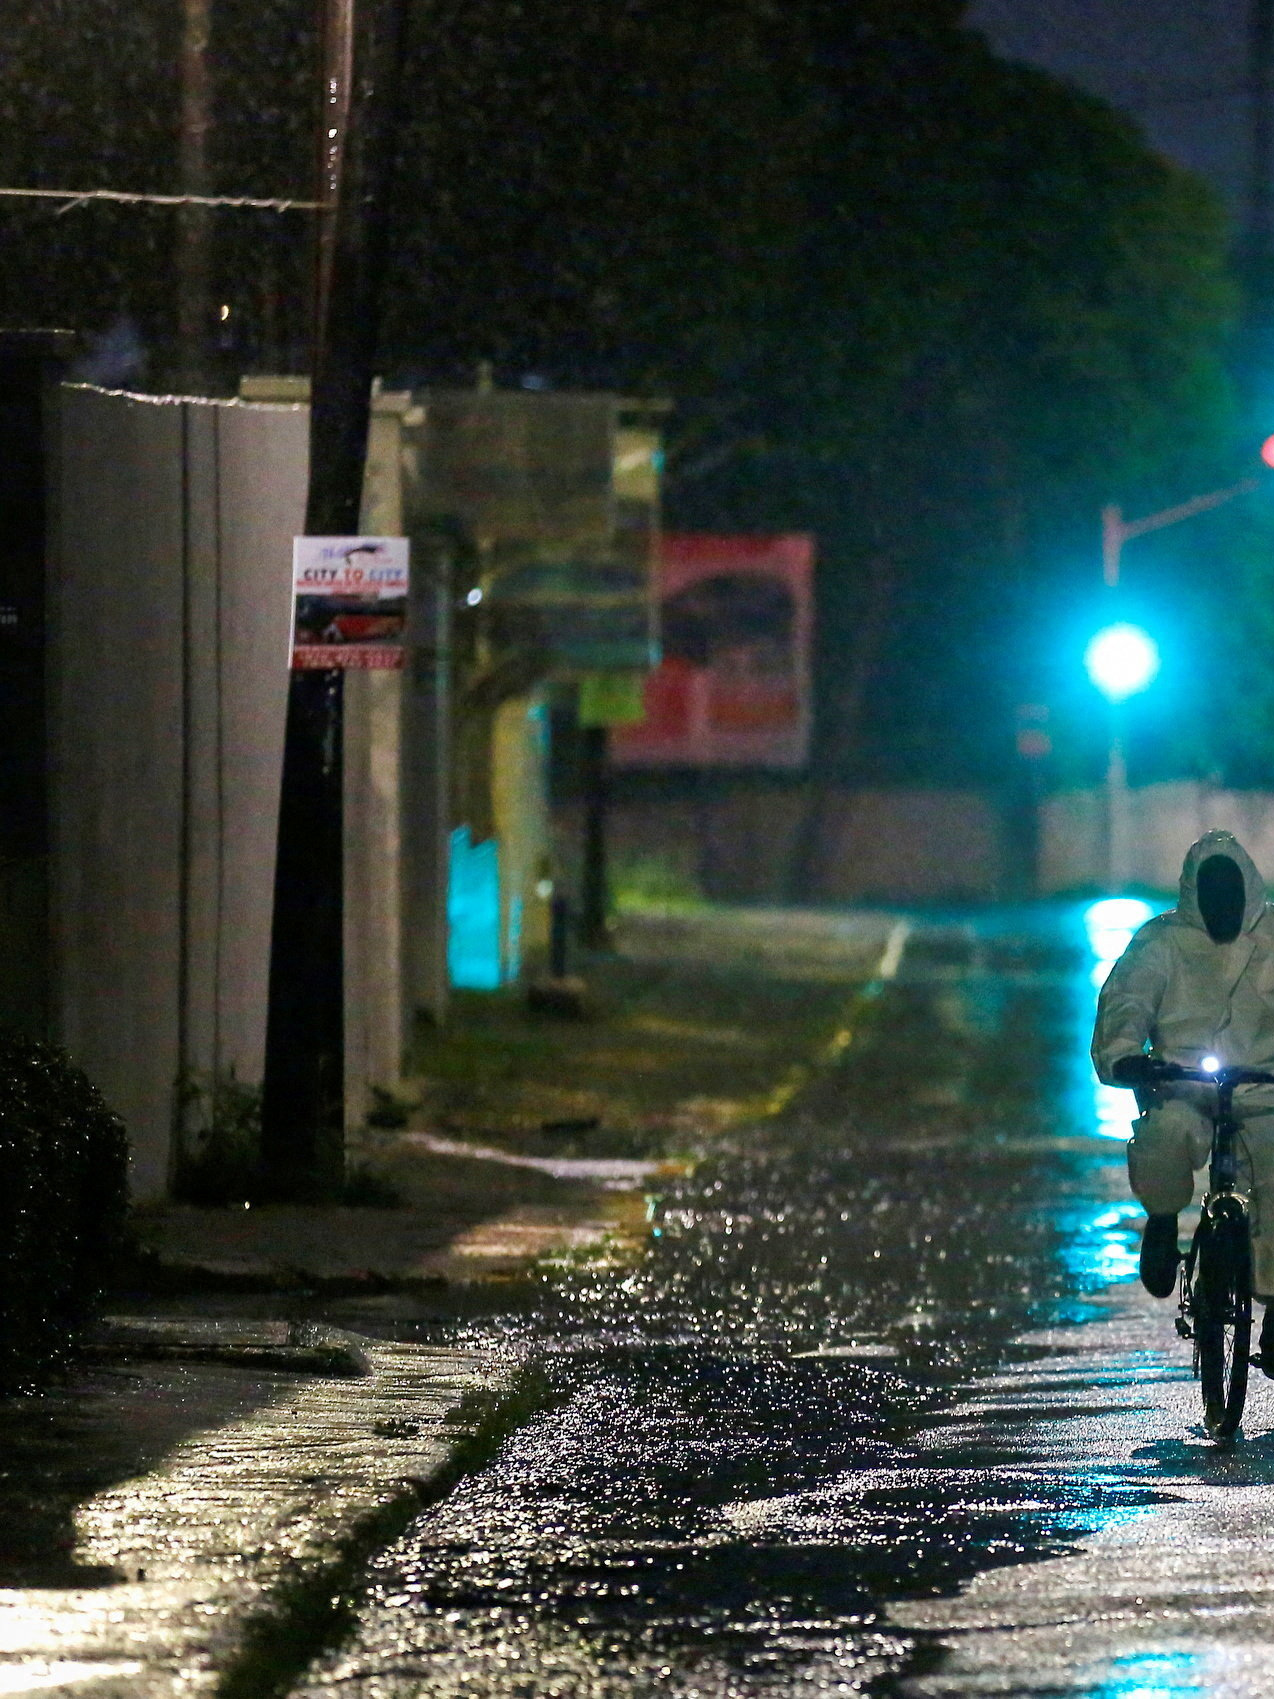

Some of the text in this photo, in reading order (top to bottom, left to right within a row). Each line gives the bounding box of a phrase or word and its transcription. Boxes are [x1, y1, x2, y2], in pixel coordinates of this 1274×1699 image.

[303, 568, 403, 582] CITY TO CITY
